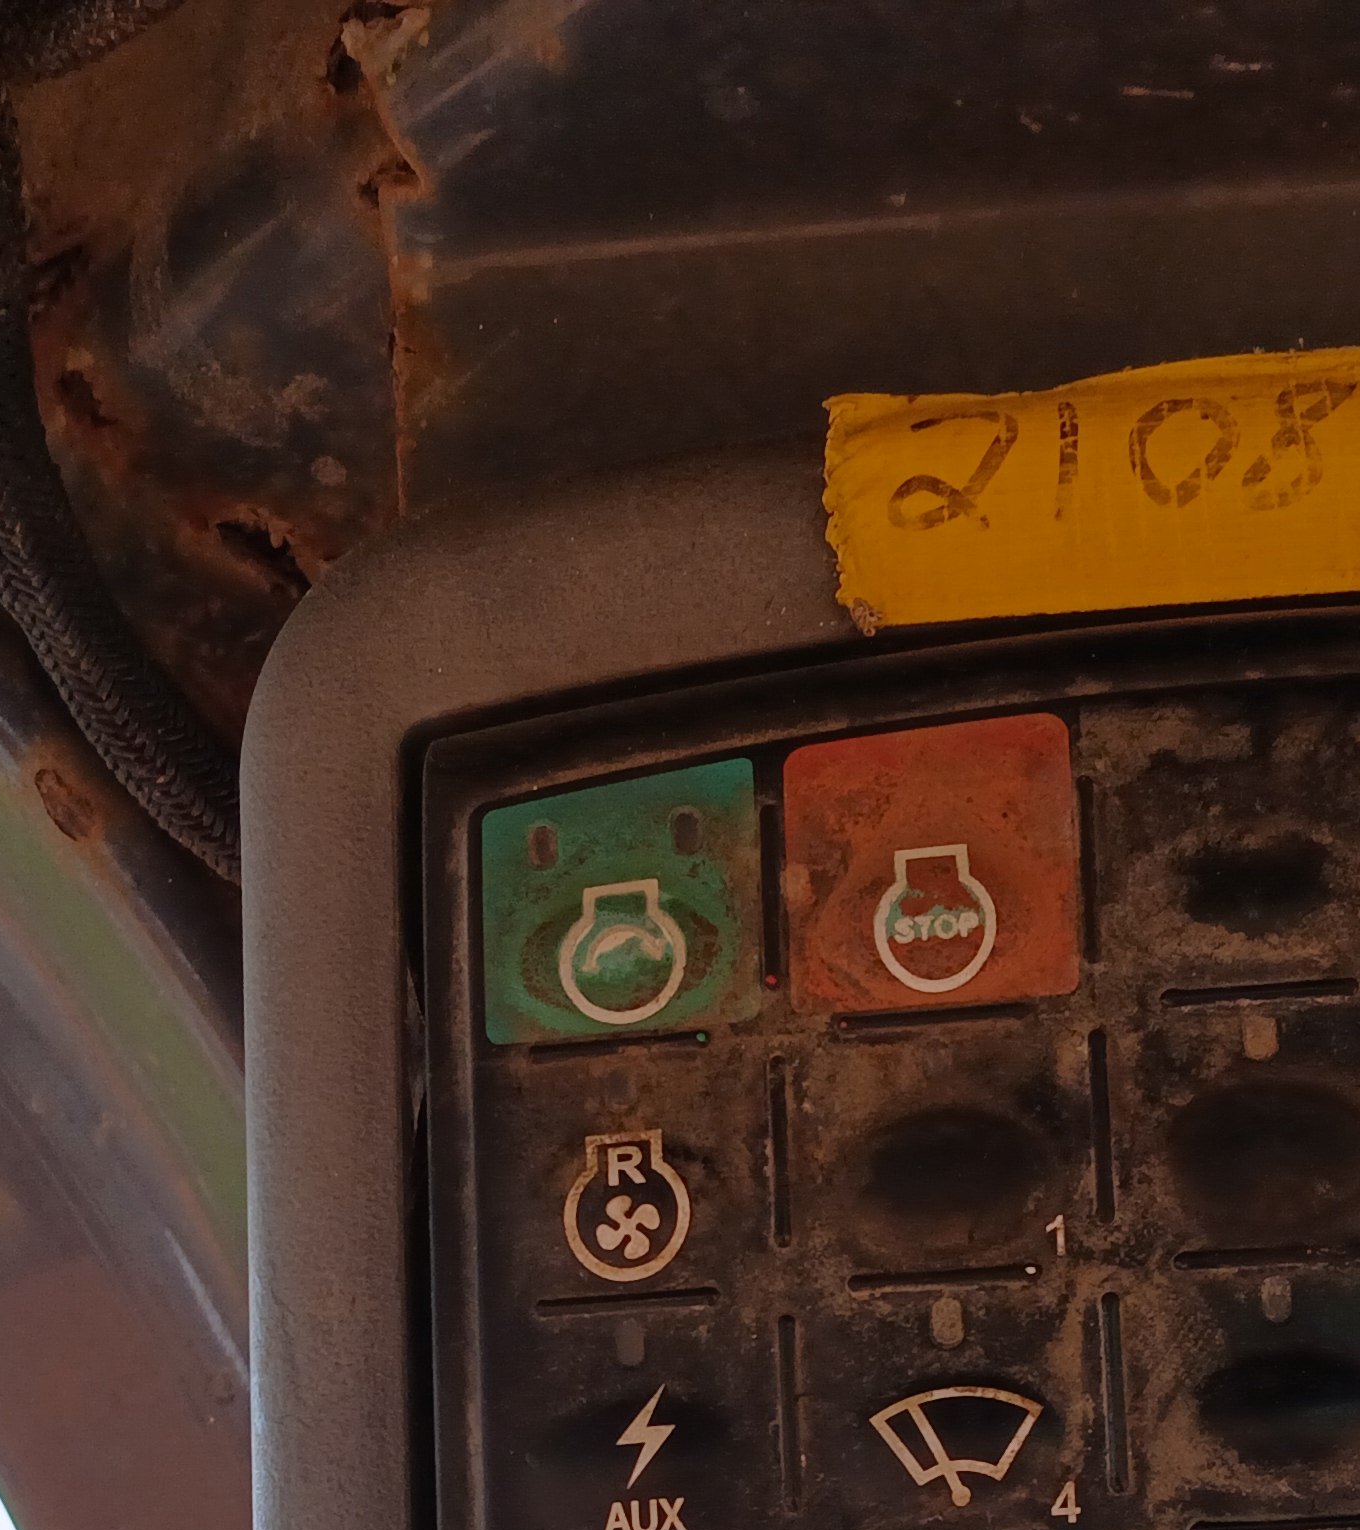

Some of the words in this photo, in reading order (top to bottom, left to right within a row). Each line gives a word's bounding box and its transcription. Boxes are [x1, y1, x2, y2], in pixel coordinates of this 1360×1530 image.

[886, 377, 1357, 531] 2108
[894, 911, 979, 944] STOP
[607, 1146, 647, 1186] R
[1045, 1215, 1065, 1257] 1
[1050, 1480, 1081, 1523] 4
